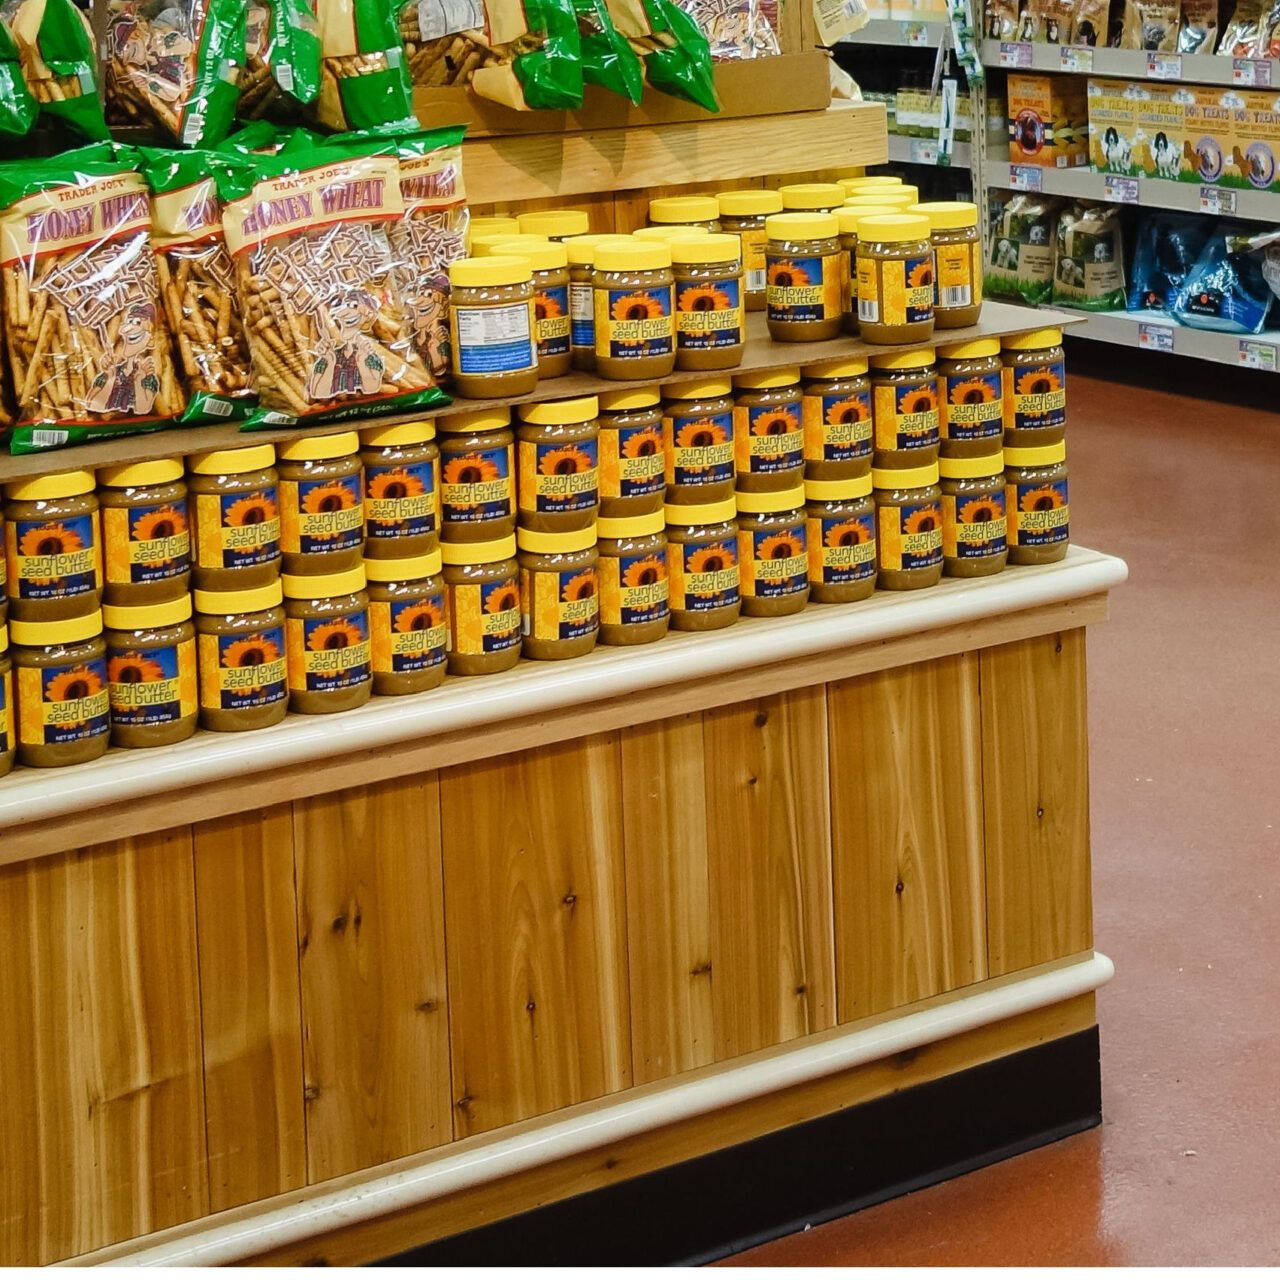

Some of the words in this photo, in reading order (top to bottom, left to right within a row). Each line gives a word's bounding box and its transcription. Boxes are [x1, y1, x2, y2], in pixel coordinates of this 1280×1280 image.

[272, 173, 316, 192] TRADER
[58, 184, 97, 202] TRADER
[241, 191, 313, 236] HONEY
[317, 177, 387, 214] WHEAT
[26, 203, 96, 244] HONEY
[683, 309, 735, 323] sunflower
[616, 318, 669, 332] sunflower
[679, 320, 704, 330] seed
[612, 329, 638, 339] seed
[1018, 402, 1043, 412] seed
[677, 455, 704, 466] seed
[447, 480, 506, 495] sunflower
[539, 483, 567, 495] seed
[372, 495, 431, 510] sunflower
[444, 492, 472, 503] seed
[368, 507, 397, 519] seed
[303, 523, 332, 534] seed
[25, 550, 91, 567] sunflower
[21, 565, 53, 577] seed
[308, 658, 339, 671] seed
[223, 676, 253, 688] seed
